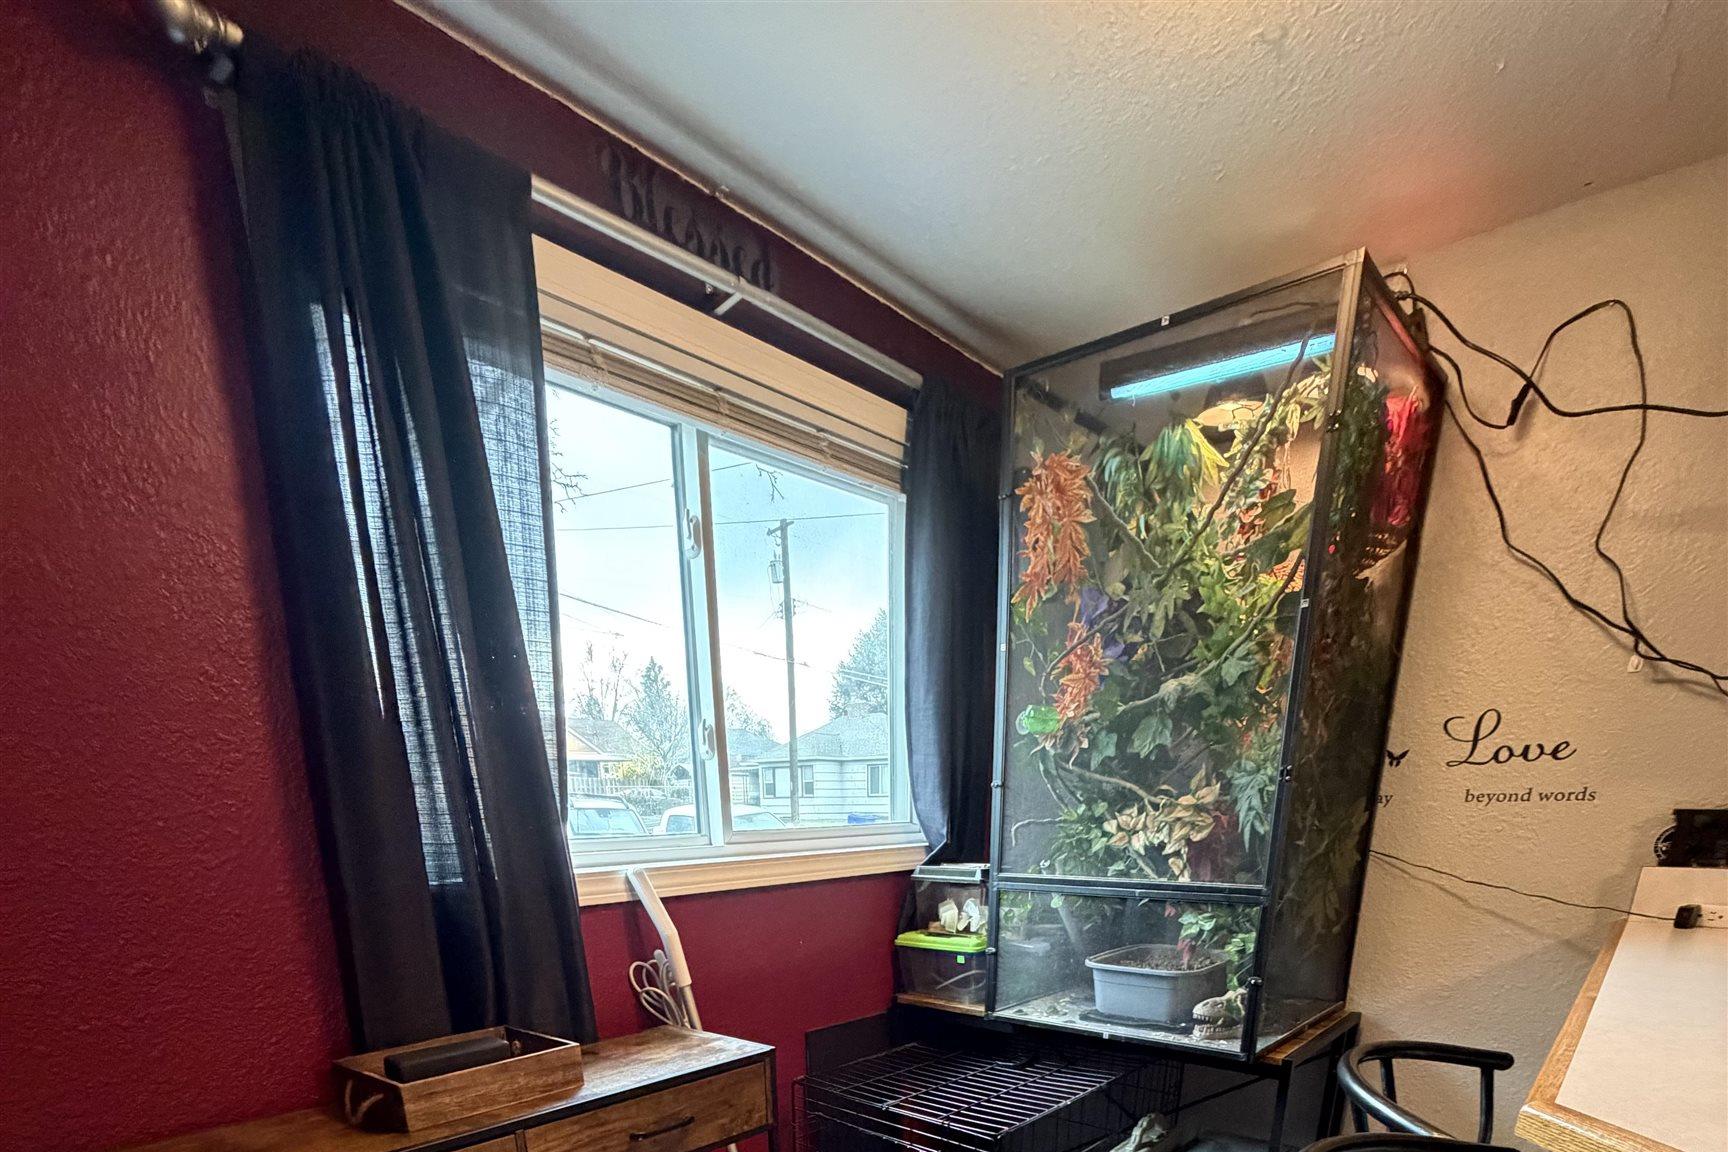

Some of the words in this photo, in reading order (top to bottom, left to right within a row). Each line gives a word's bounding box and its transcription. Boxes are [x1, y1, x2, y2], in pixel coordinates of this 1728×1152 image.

[1443, 708, 1577, 768] Love
[1464, 788, 1533, 807] beyond
[1538, 786, 1598, 803] words
